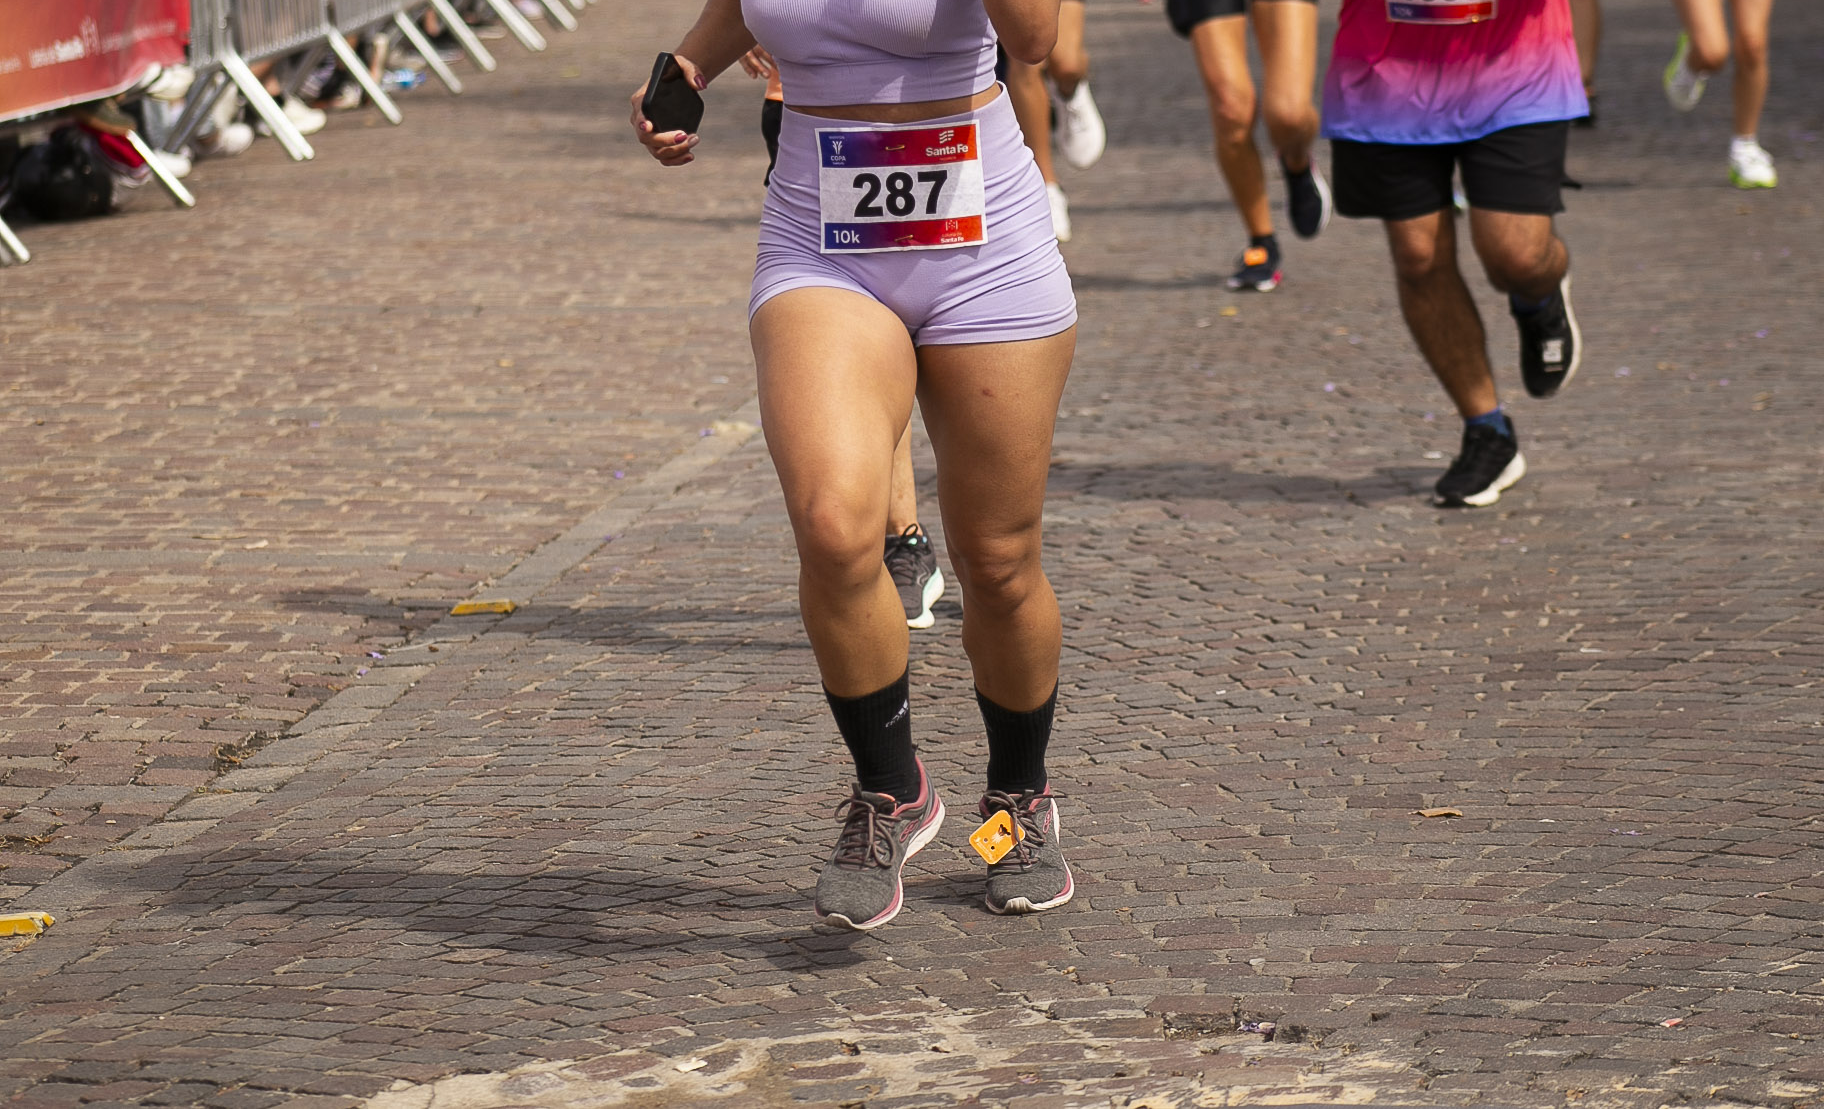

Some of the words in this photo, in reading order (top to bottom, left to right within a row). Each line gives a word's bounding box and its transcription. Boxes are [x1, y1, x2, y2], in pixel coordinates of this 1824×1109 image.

[925, 146, 957, 157] Santa
[956, 143, 969, 154] Fe
[852, 170, 949, 218] 287
[833, 230, 861, 244] 10k
